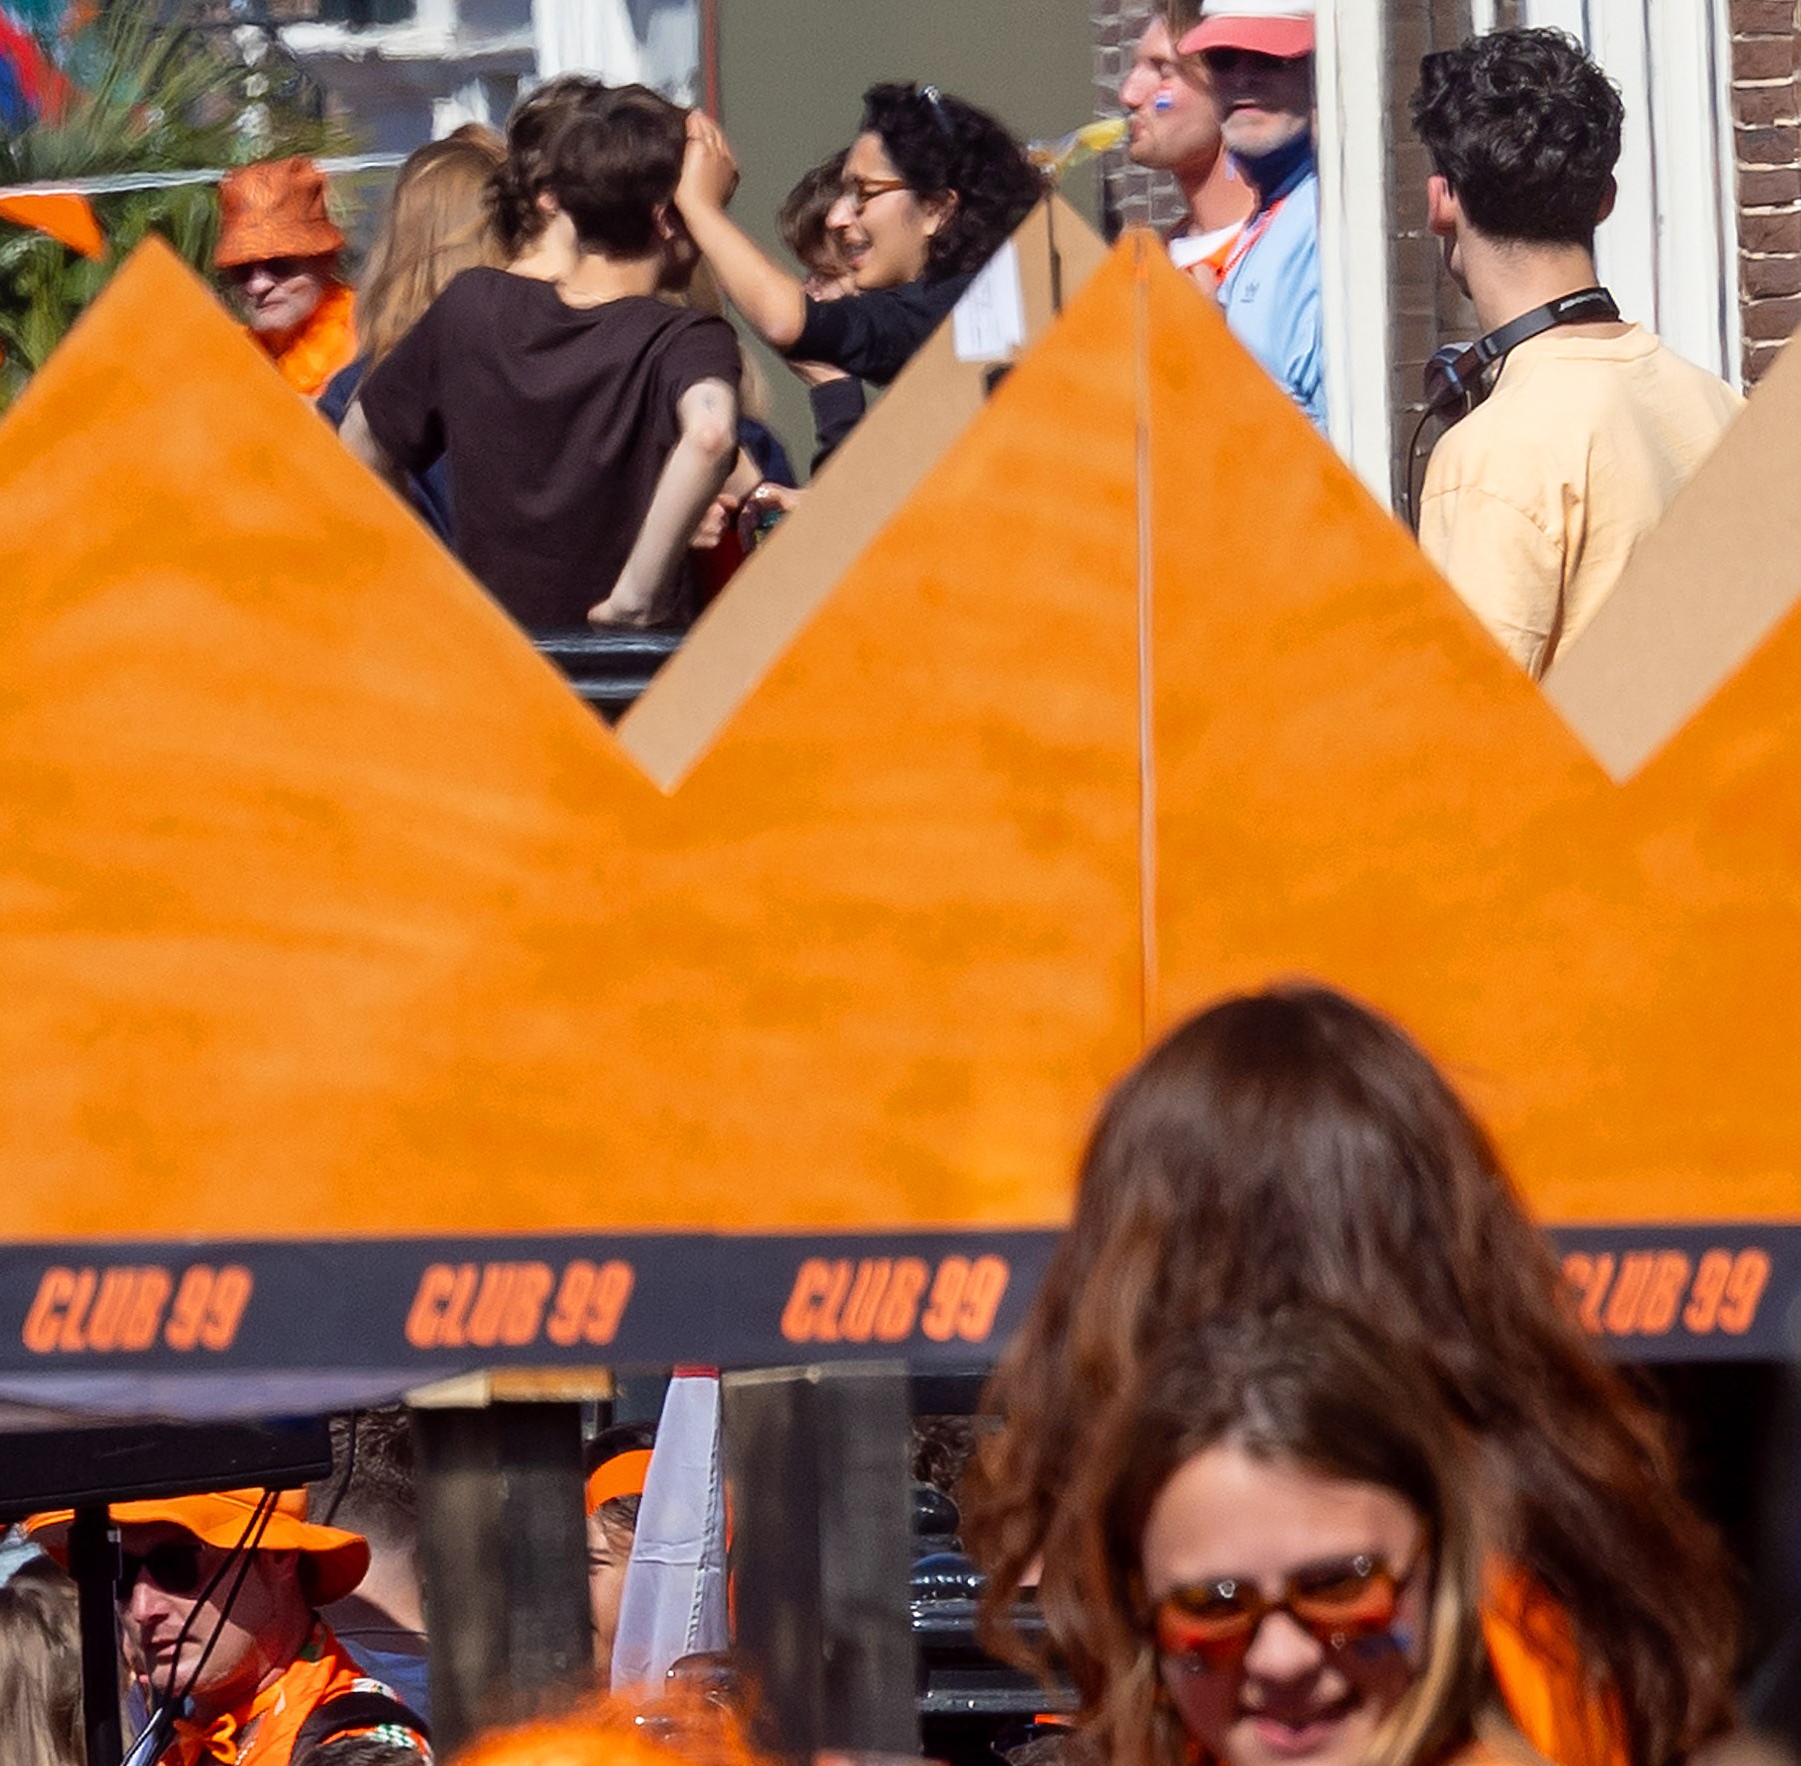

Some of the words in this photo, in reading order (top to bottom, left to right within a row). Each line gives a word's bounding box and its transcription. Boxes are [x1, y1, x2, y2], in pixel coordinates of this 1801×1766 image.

[22, 1266, 168, 1354] CLUB
[166, 1265, 253, 1351] 99
[404, 1261, 549, 1349] CLUB
[547, 1259, 635, 1347] 99
[779, 1257, 924, 1343] CLUB
[922, 1254, 1010, 1342] 99
[1683, 1247, 1772, 1336] 99
